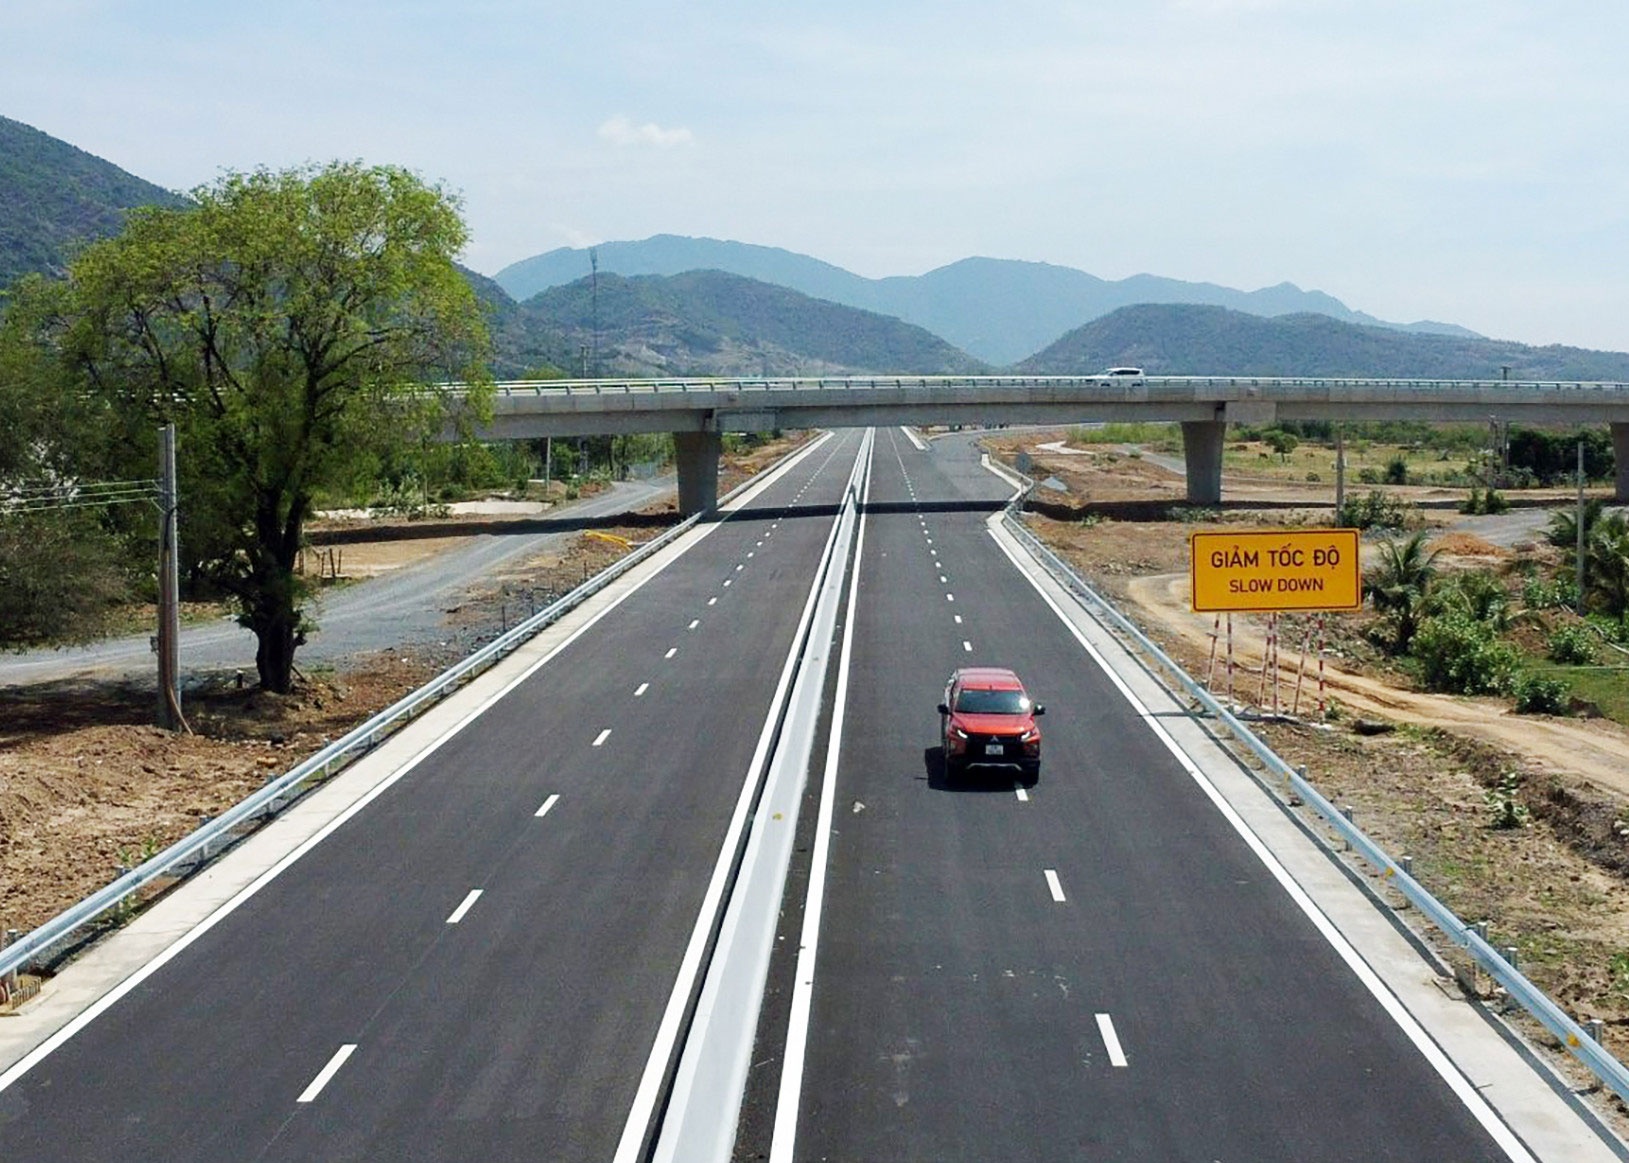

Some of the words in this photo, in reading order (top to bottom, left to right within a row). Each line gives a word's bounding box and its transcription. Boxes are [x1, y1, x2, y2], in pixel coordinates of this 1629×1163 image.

[1211, 545, 1259, 568] GIẢM
[1267, 543, 1304, 567] TỐC
[1313, 545, 1340, 569] ĐỘ
[1229, 579, 1273, 593] SLOW
[1278, 578, 1323, 592] DOWN
